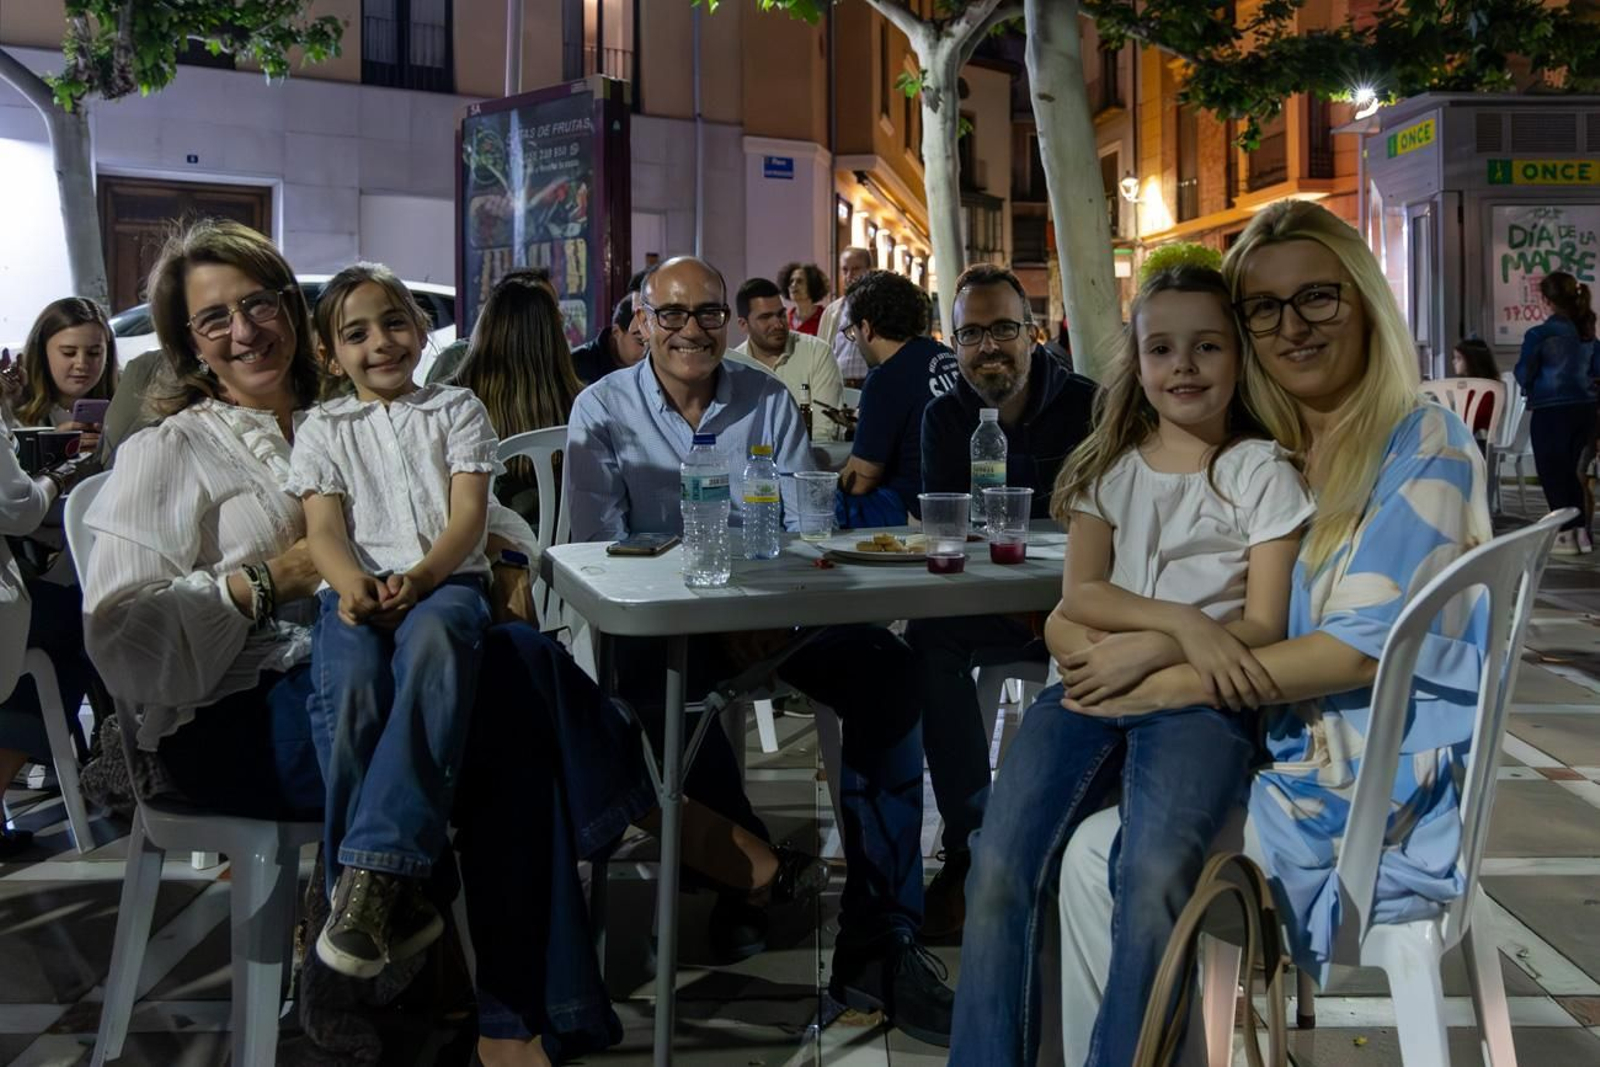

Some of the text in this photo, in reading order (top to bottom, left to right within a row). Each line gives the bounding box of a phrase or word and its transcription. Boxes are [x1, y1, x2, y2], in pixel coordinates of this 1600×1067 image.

[537, 124, 551, 138] DE
[552, 117, 591, 136] FRUTAS
[1401, 123, 1432, 150] ONCE
[1522, 163, 1592, 181] ONCE
[1508, 222, 1556, 249] DÍA
[1557, 224, 1577, 240] DE
[1501, 240, 1596, 283] MADRE
